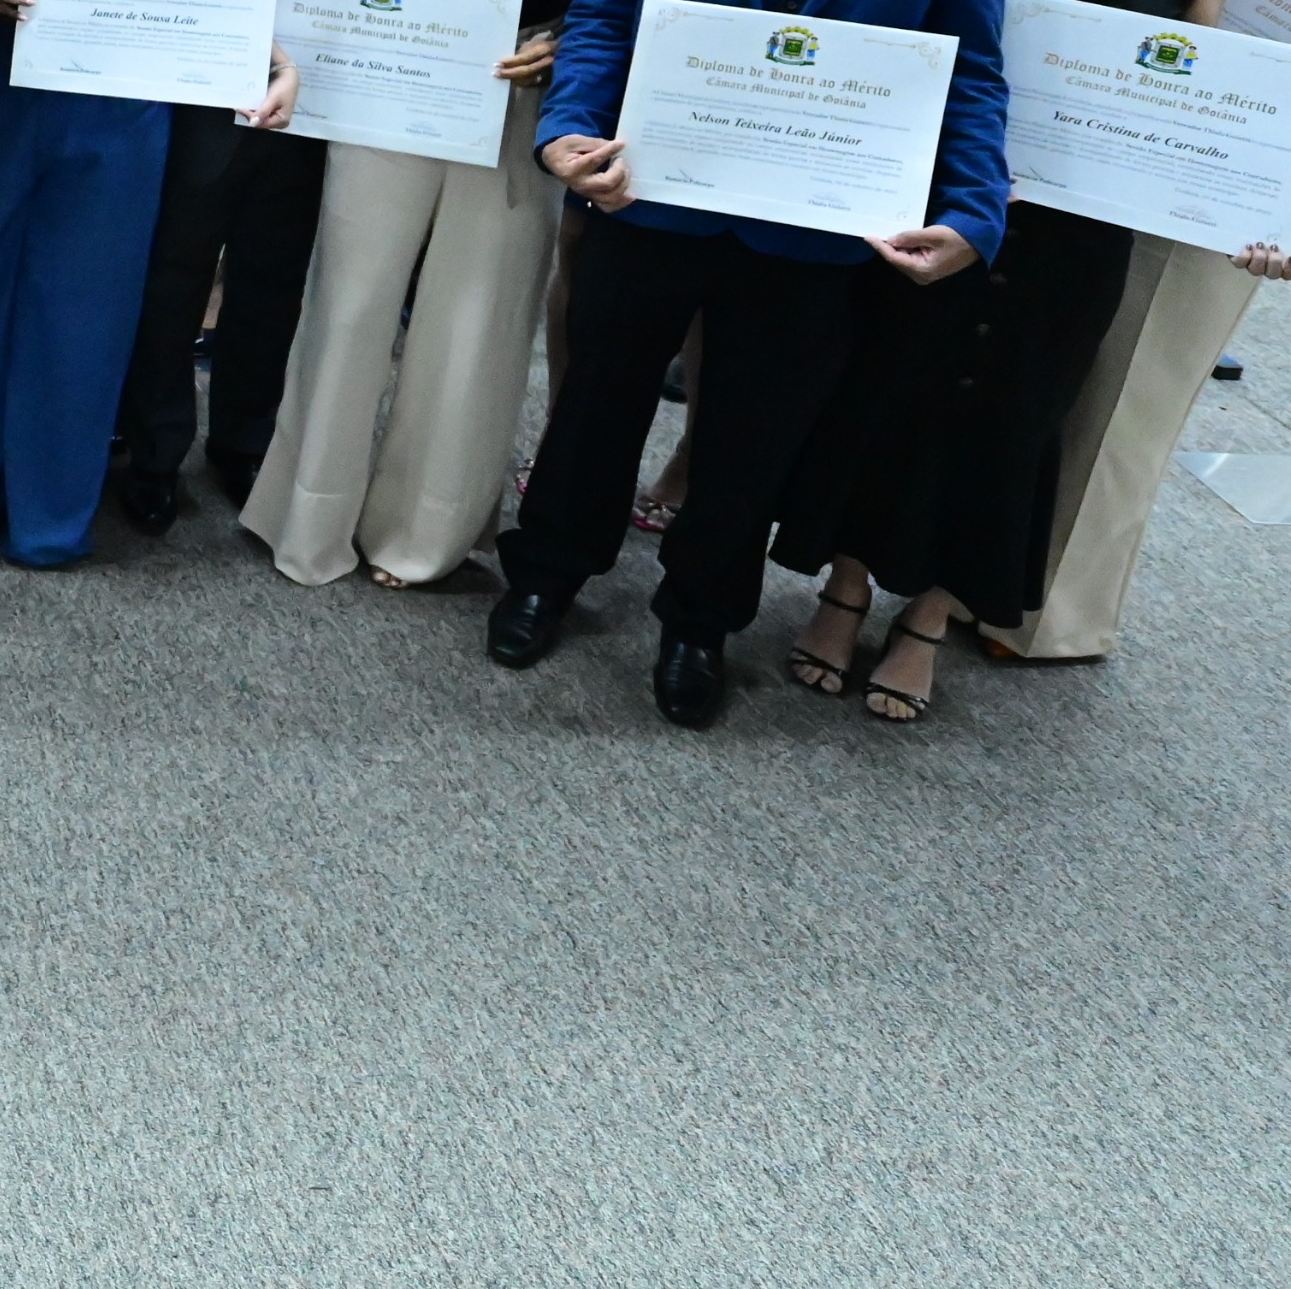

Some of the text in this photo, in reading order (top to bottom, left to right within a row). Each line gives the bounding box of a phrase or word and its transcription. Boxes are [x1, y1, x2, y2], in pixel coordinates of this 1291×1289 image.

[90, 9, 199, 25] Janete de Sousa Leite
[293, 2, 343, 19] Diploma
[348, 11, 360, 21] de
[365, 13, 403, 28] Honra
[425, 23, 468, 38] Mérito
[399, 34, 408, 42] de
[314, 54, 431, 77] Eliane da Silva Santos
[687, 56, 891, 97] Diploma de Honra ao Mérito
[808, 92, 819, 101] de
[1043, 51, 1276, 114] Diploma de Honra ao Mérito
[1181, 102, 1193, 111] de
[691, 112, 863, 145] Nelson Teixeira Leão Júnior
[1053, 111, 1229, 159] Yara Cristina de Carvalho
